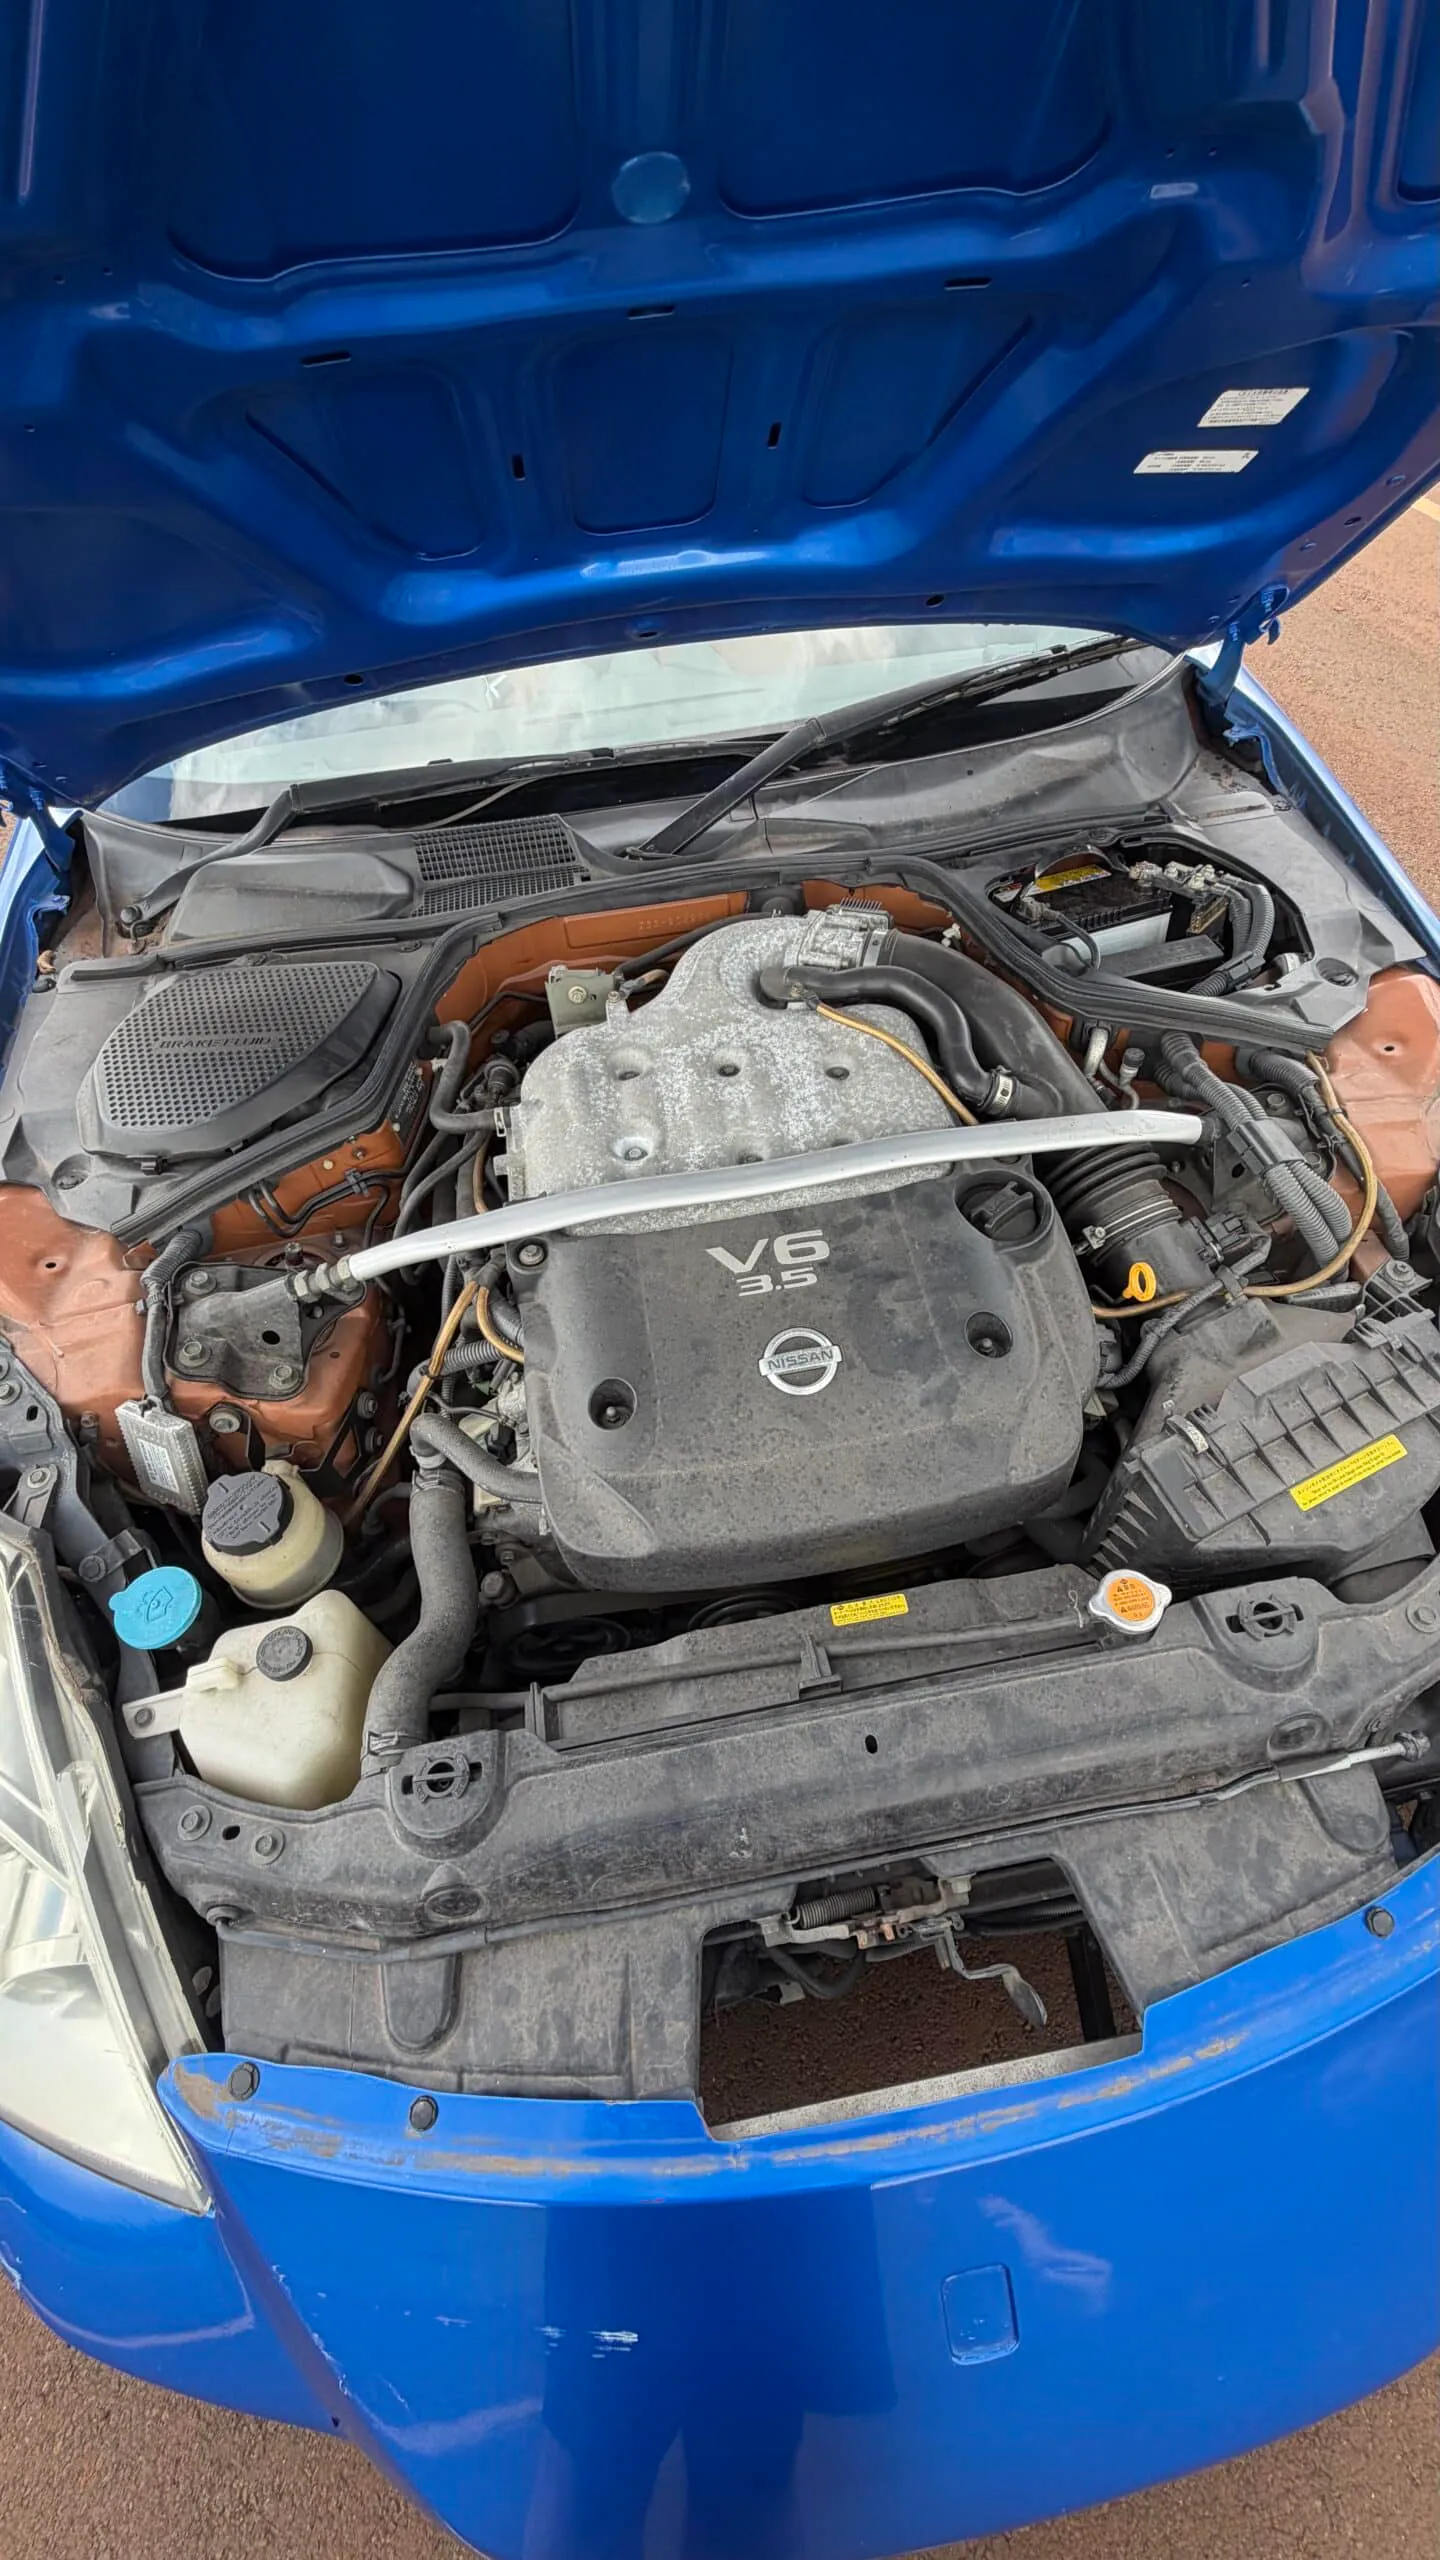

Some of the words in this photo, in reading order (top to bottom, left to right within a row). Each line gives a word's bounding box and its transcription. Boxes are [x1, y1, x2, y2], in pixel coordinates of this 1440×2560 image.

[160, 1039, 222, 1049] BRAKE
[223, 1036, 272, 1046] FLUID
[705, 1229, 831, 1274] V6
[736, 1267, 818, 1297] 3.5
[767, 1348, 833, 1371] NISSAN
